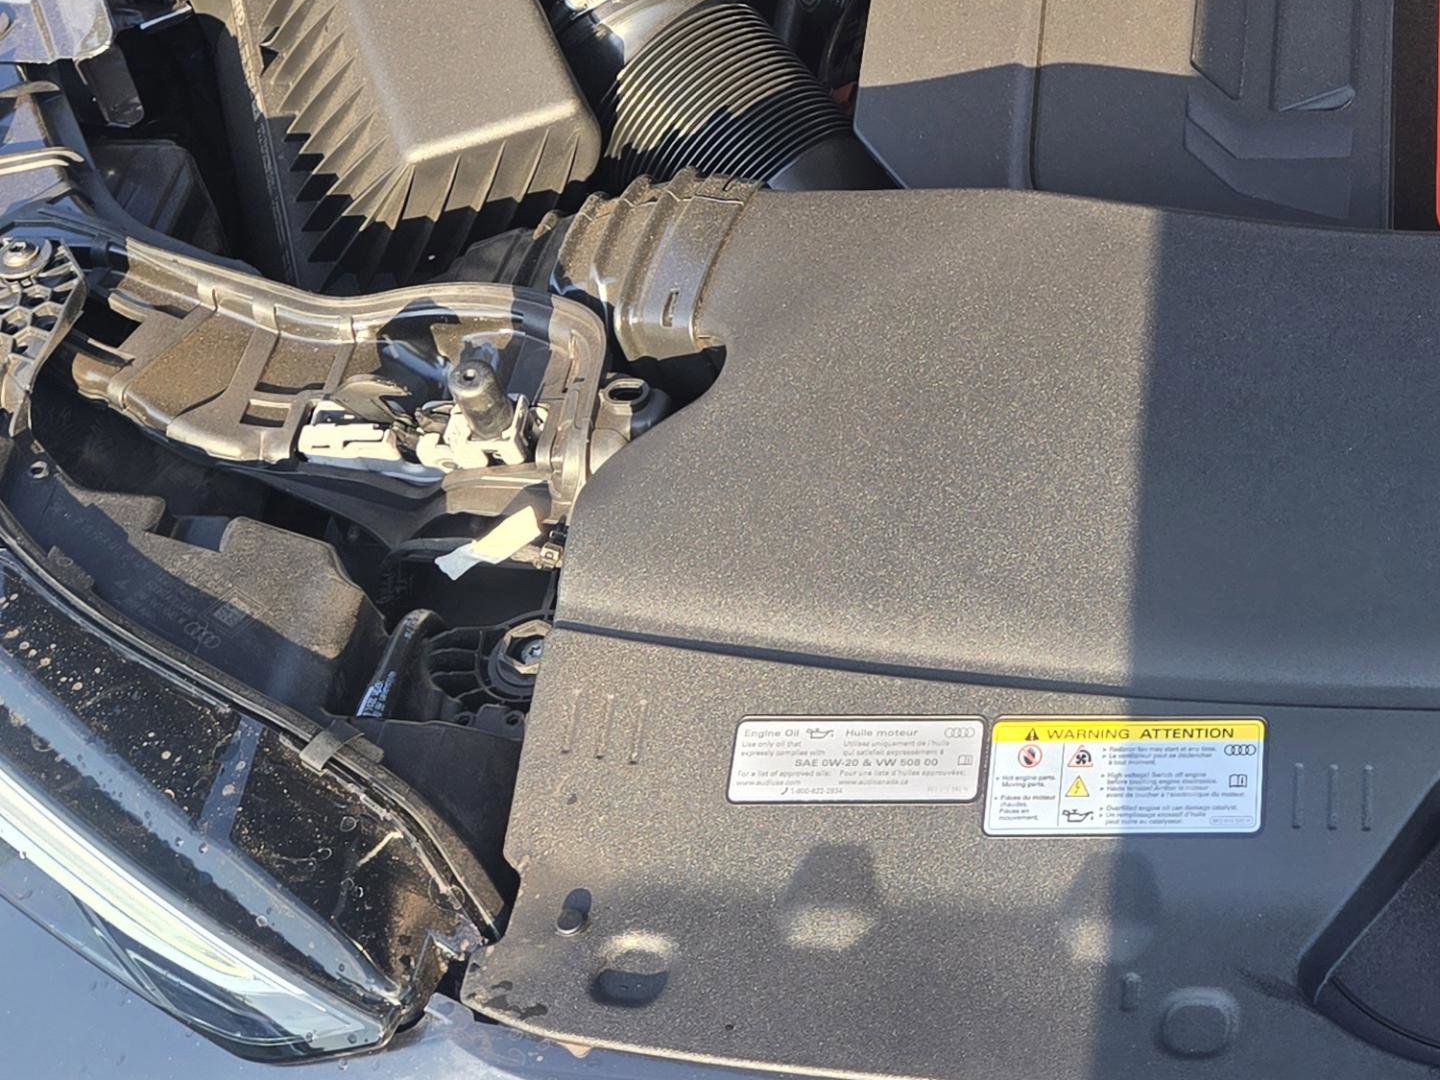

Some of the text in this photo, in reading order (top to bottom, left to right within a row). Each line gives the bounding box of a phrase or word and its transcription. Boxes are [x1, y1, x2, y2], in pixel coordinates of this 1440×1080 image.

[745, 729, 799, 738] Engine Oil
[846, 729, 872, 737] Huile
[1047, 728, 1235, 739] WARNING ATTENTION
[795, 759, 939, 767] SAE 0W-20 & VW 508 00
